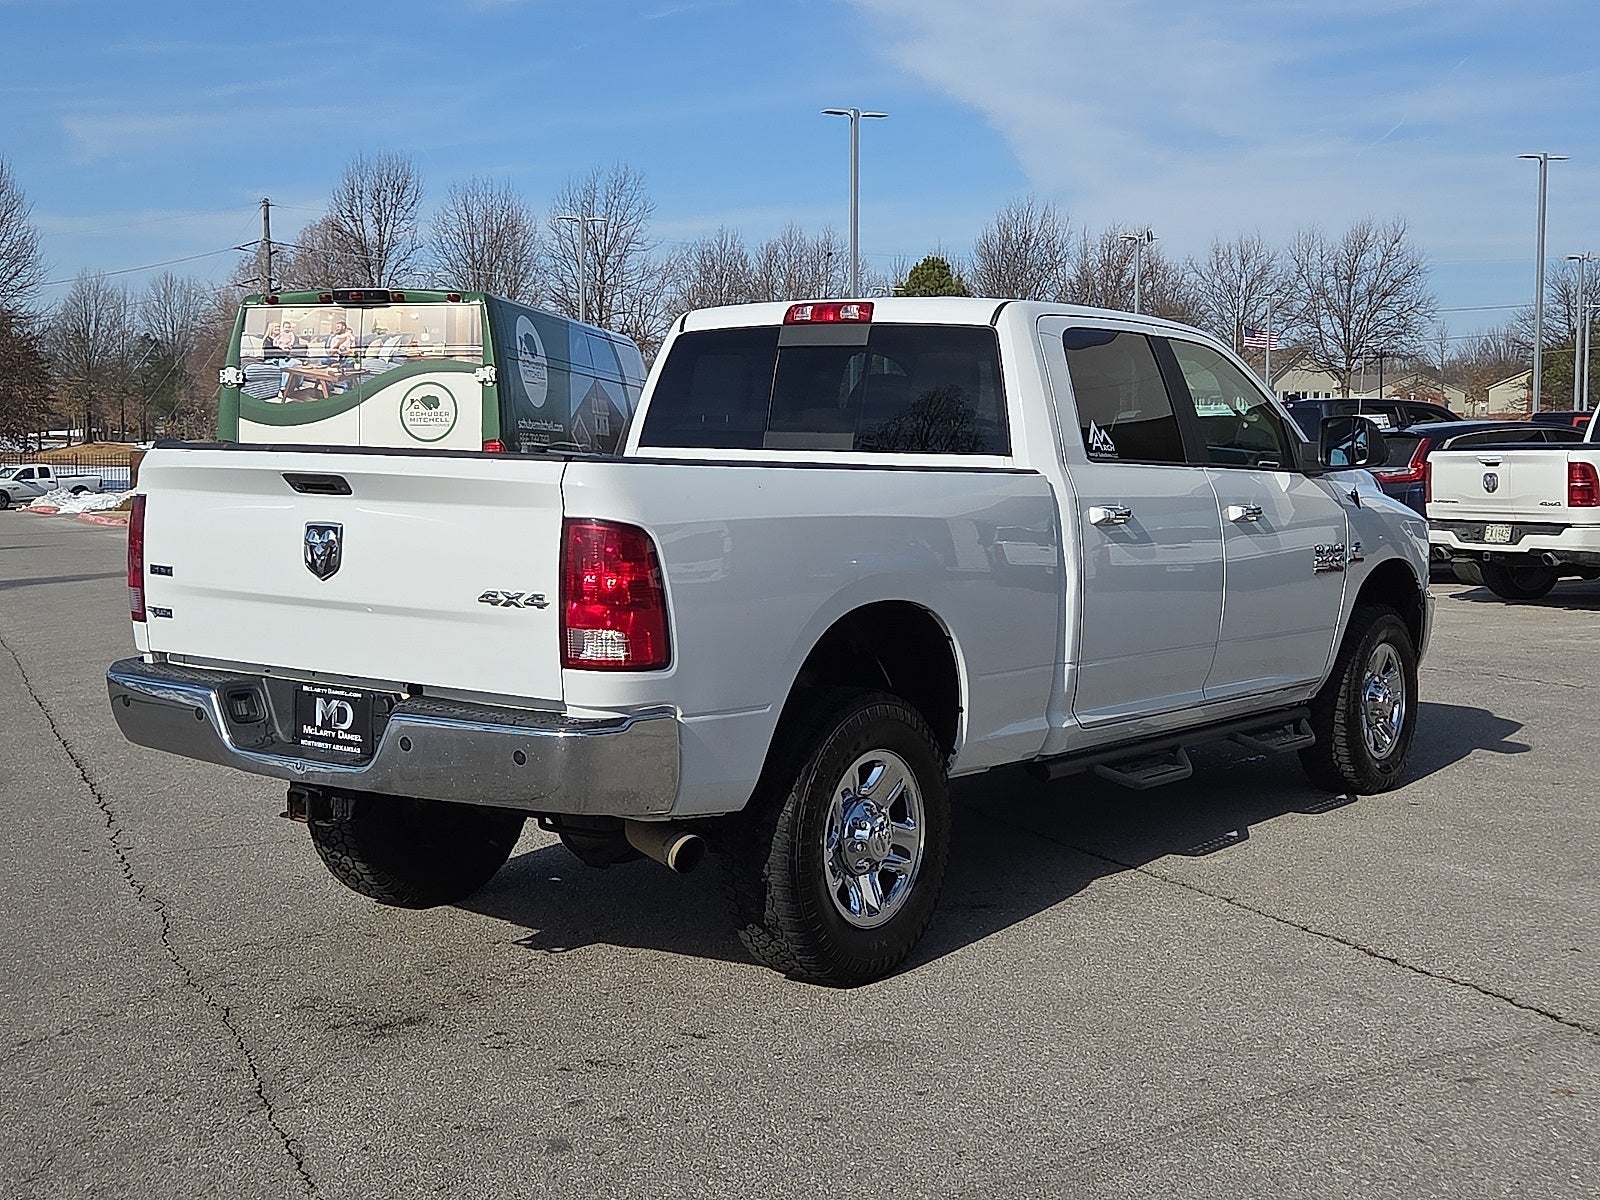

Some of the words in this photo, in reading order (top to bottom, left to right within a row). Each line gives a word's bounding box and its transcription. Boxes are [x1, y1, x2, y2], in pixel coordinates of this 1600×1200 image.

[477, 590, 550, 609] 4X4
[315, 697, 354, 730] MD
[337, 730, 363, 743] DANIEL
[300, 739, 332, 751] NORTHWEST
[332, 743, 361, 754] ARKANSAS
